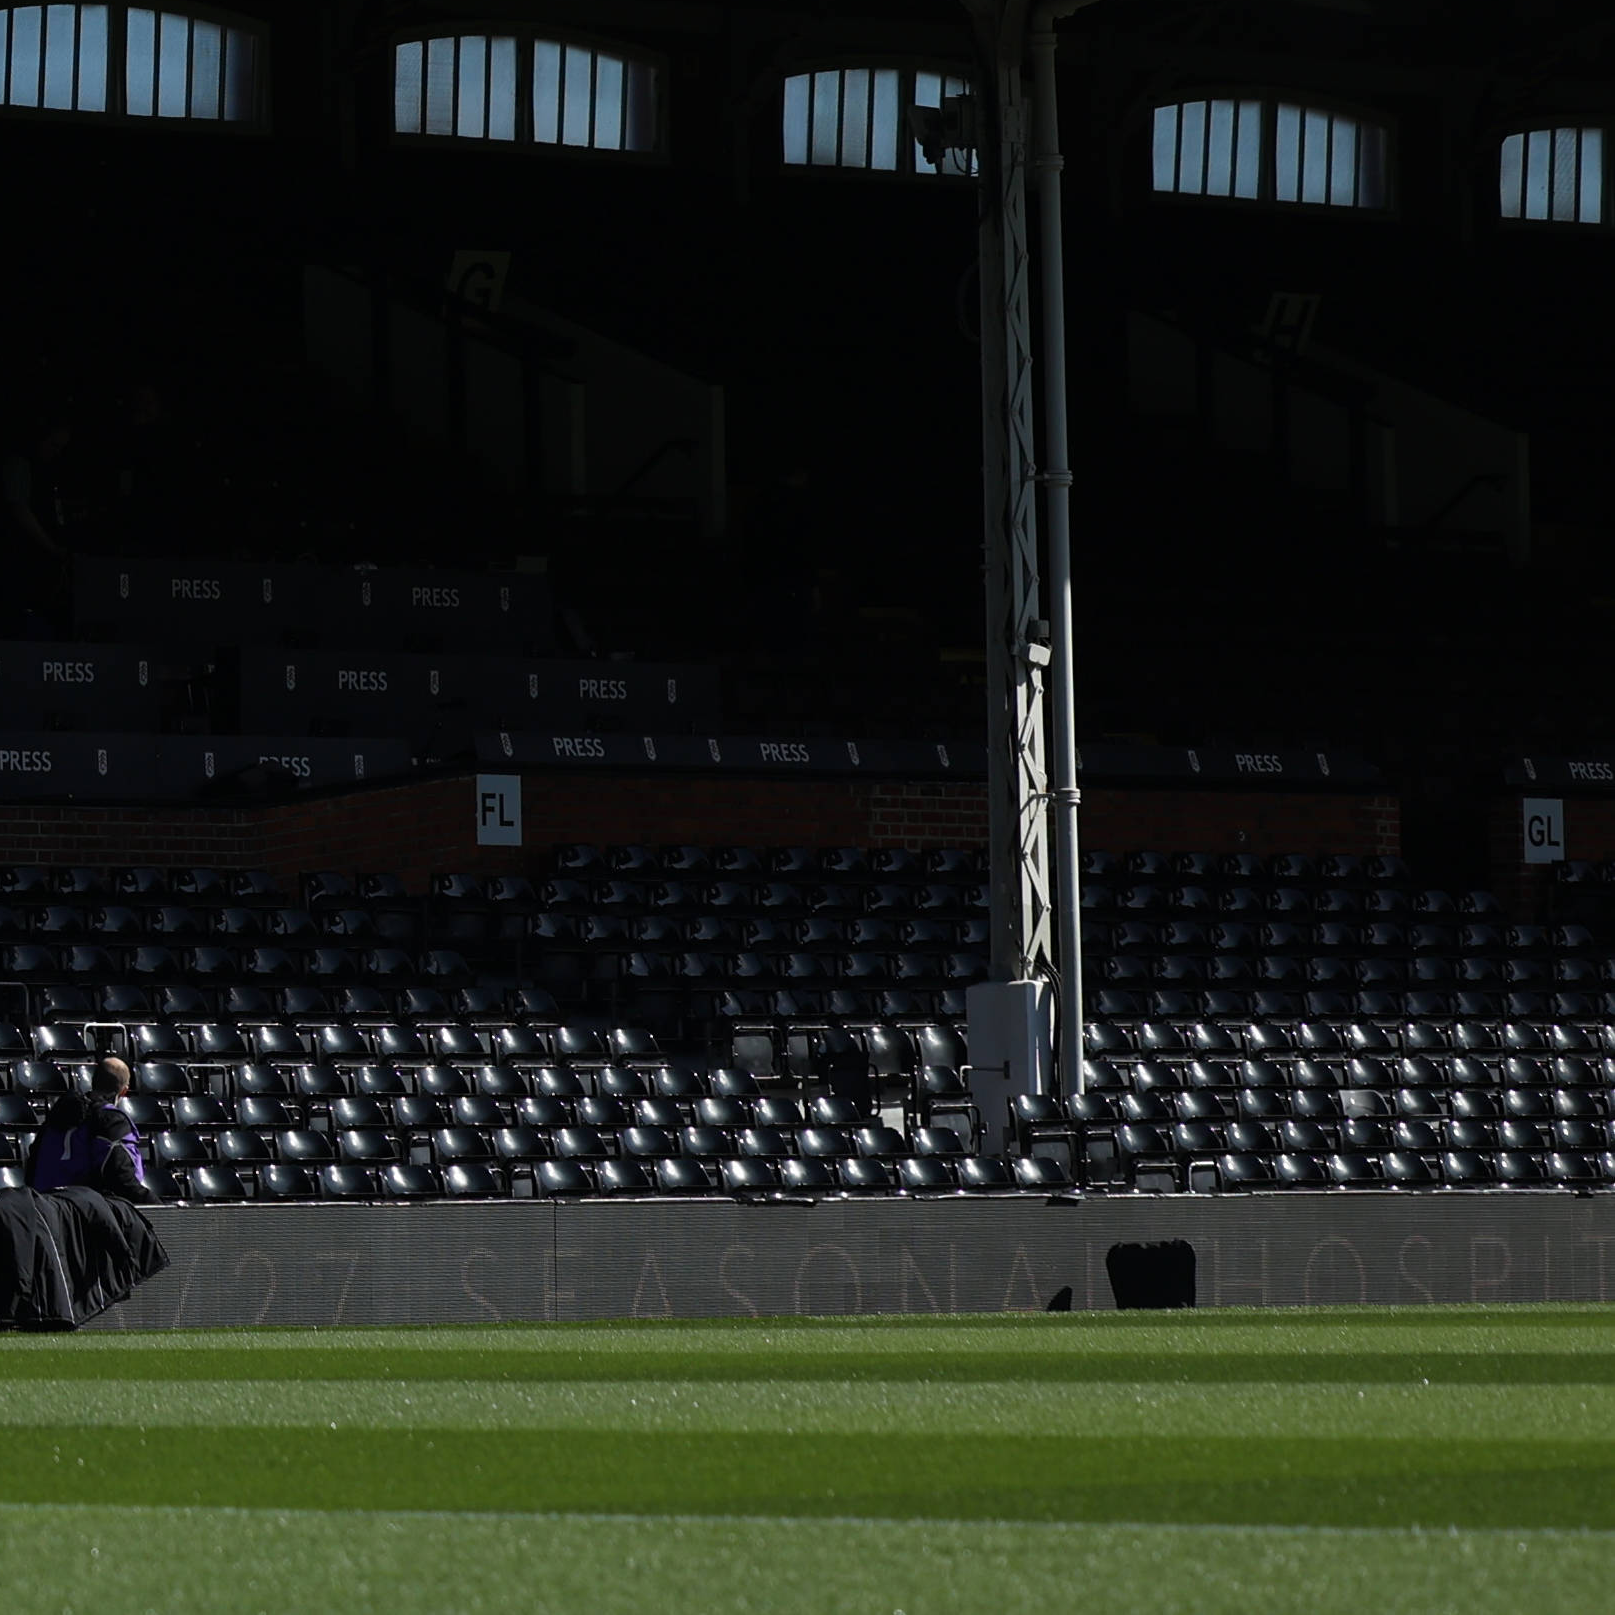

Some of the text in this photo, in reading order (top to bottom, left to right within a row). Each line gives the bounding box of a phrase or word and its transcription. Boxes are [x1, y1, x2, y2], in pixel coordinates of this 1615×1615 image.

[171, 579, 221, 599] PRESS
[412, 587, 459, 607] PRESS
[43, 662, 94, 682] PRESS
[338, 670, 387, 691] PRESS
[579, 679, 626, 699] PRESS
[553, 737, 605, 757] PRESS
[760, 743, 810, 762] PRESS
[0, 750, 52, 771] PRESS
[259, 756, 311, 777] ESS
[1235, 754, 1283, 773] PRESS
[1568, 762, 1614, 779] PRESS
[481, 793, 514, 827] FL
[1528, 815, 1561, 847] GL
